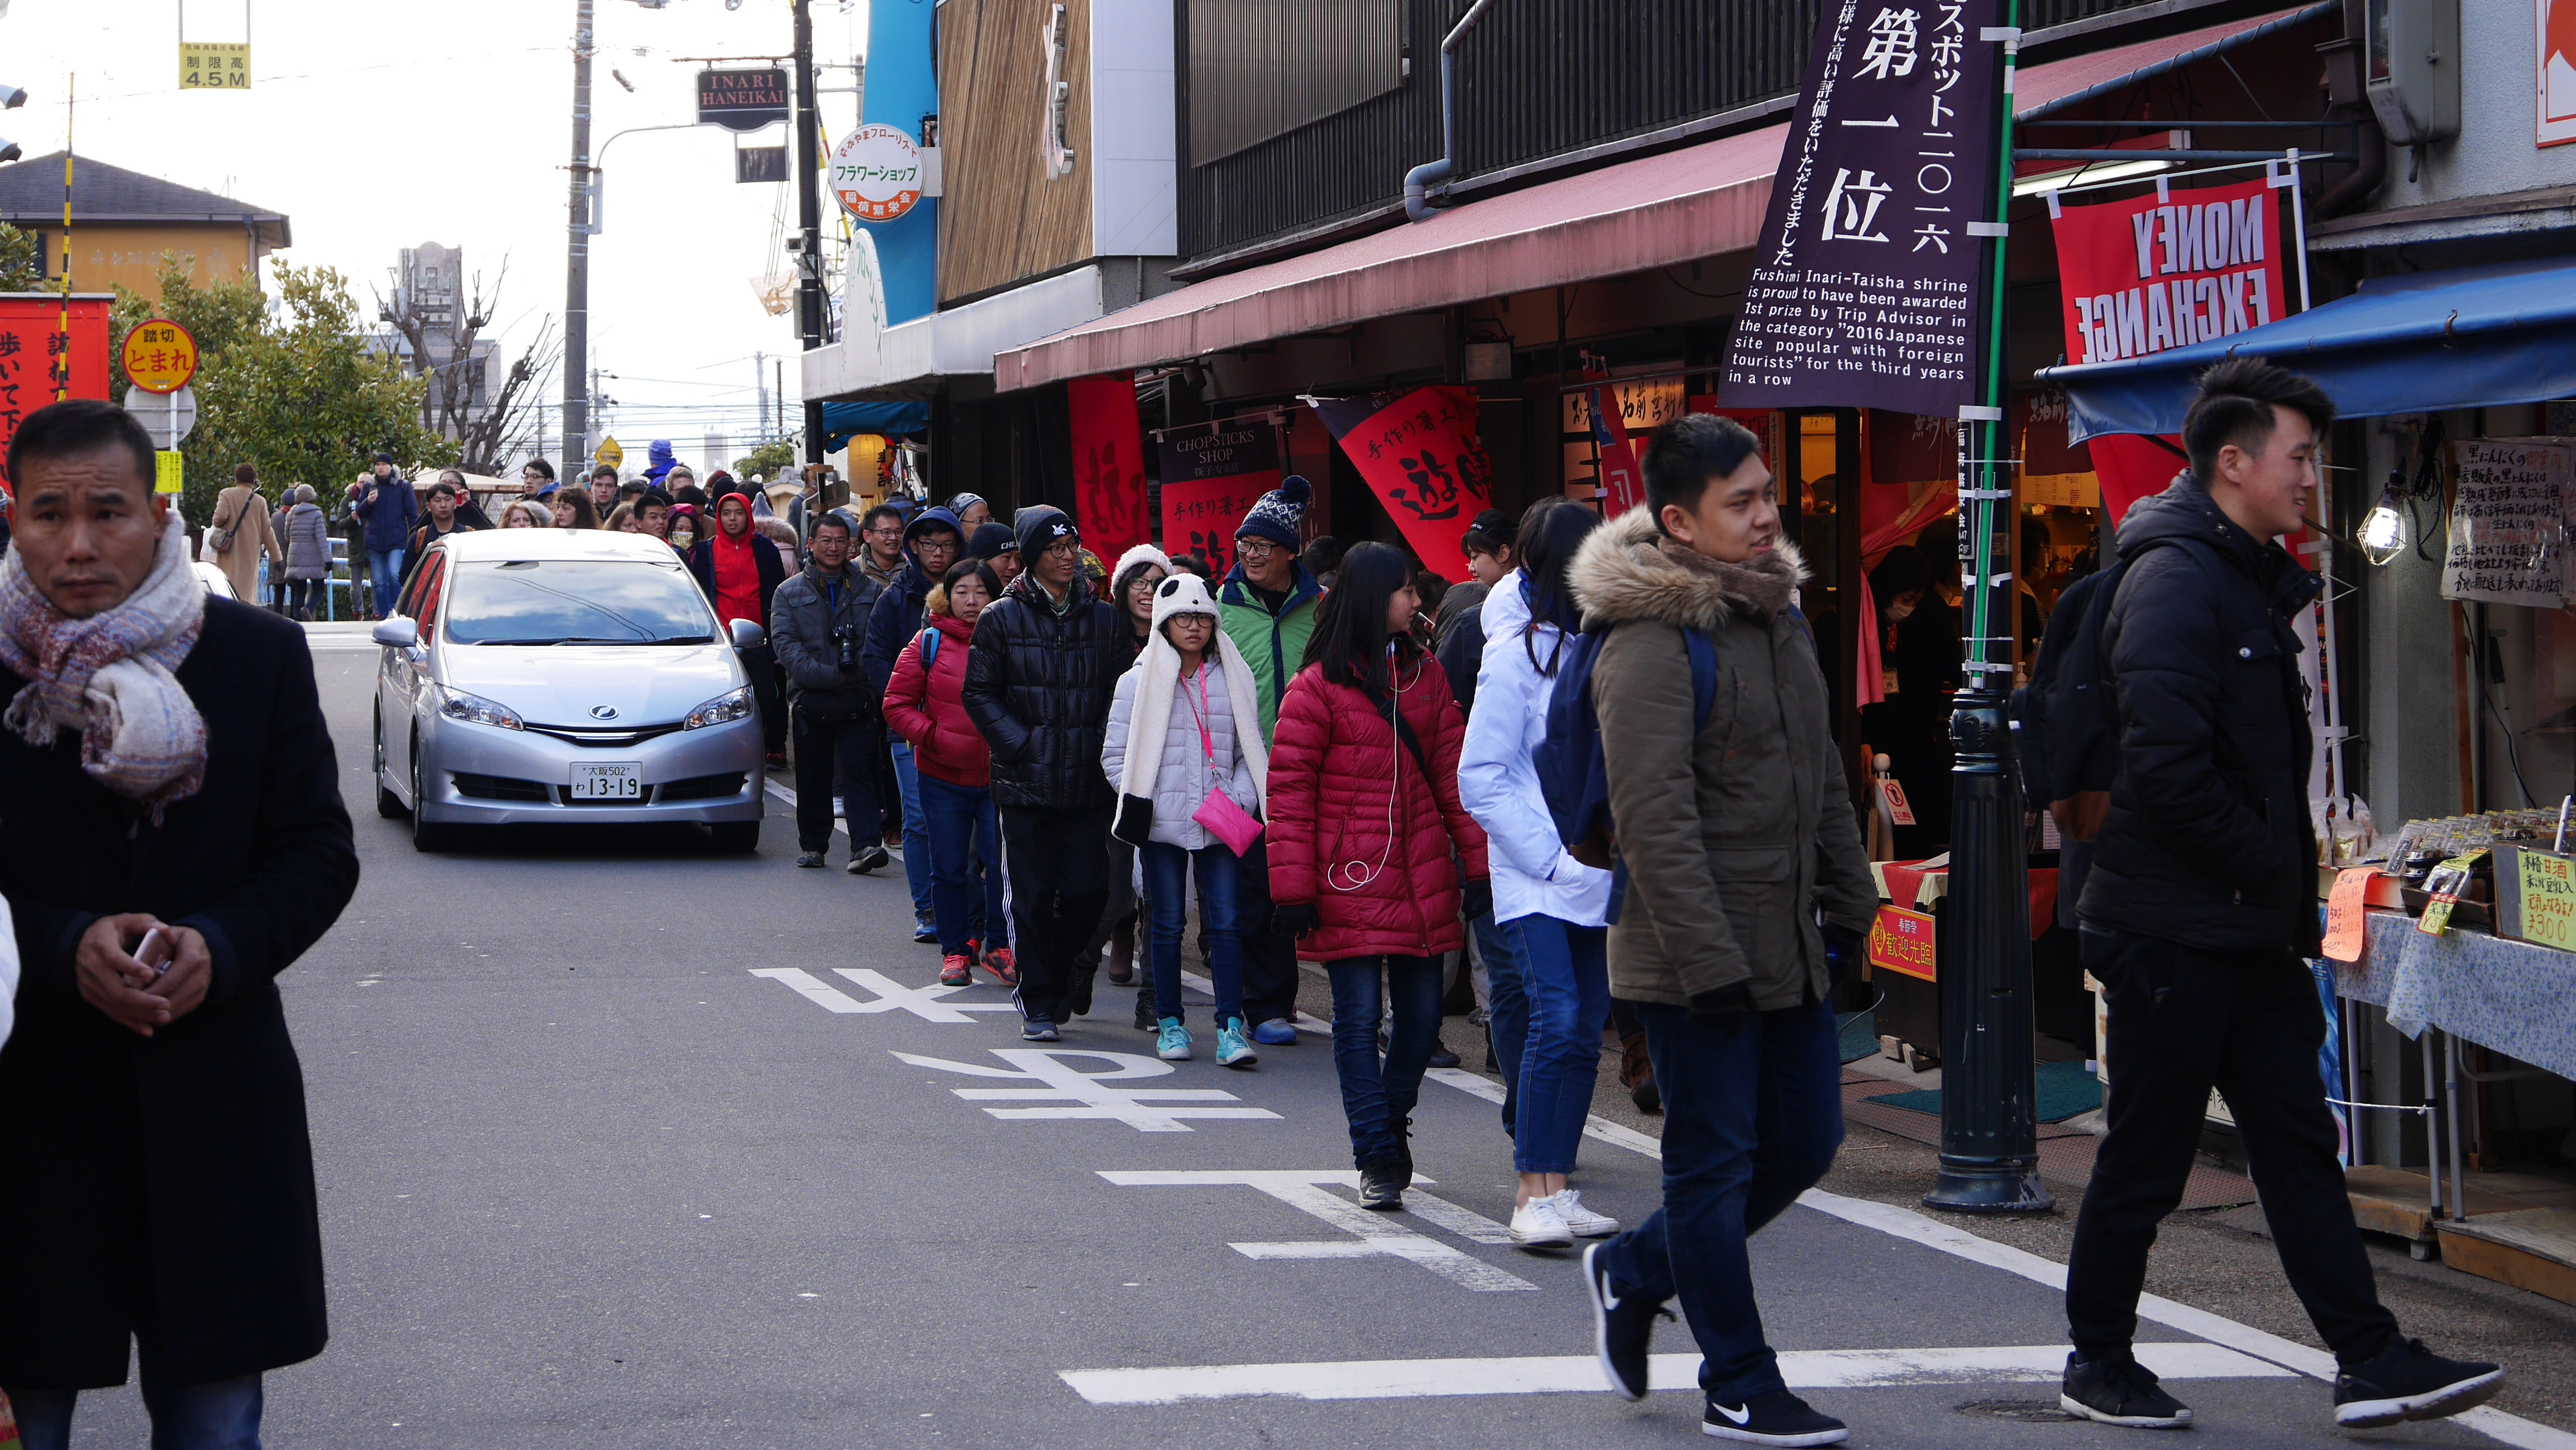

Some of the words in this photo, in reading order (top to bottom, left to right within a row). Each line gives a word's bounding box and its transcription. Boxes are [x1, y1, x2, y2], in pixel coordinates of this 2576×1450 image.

[186, 56, 243, 68] 制限高
[711, 74, 774, 89] INARI
[702, 90, 785, 105] HANEIKAI
[1821, 7, 1921, 242] 第一位
[1912, 0, 1965, 254] スポット二〇一六
[840, 129, 917, 158] なかやまフローリスト
[836, 164, 918, 182] フラワーショップ
[845, 191, 910, 216] 稲荷繁栄会
[1752, 268, 1801, 283] Fushimi
[1806, 269, 1905, 289] Inari-Taisha
[1913, 278, 1967, 292] shrine
[1748, 285, 1759, 297] is
[1762, 287, 1798, 299] proud
[1802, 287, 1816, 300] to
[1821, 287, 1853, 302] have
[1860, 291, 1896, 306] been
[1902, 296, 1967, 310] awarded
[1745, 302, 1763, 314] 1st
[1768, 304, 1802, 316] prize
[1810, 304, 1828, 320] by
[1837, 306, 1867, 323] Trip
[1876, 310, 1942, 325] Advisor
[1952, 314, 1966, 327] in
[144, 328, 174, 343] 踏切
[1740, 319, 1761, 332] the
[1767, 322, 1834, 338] category
[1886, 328, 1965, 346] Japanese
[129, 348, 191, 372] とまれ
[1735, 336, 1763, 349] site
[1776, 341, 1839, 354] popular
[1852, 343, 1886, 357] with
[1898, 346, 1963, 363] foreign
[1729, 369, 1741, 382] in
[1748, 374, 1756, 384] a
[1764, 375, 1792, 386] row
[1806, 357, 1829, 370] for
[1837, 359, 1863, 370] the
[1871, 360, 1911, 376] third
[1920, 368, 1964, 379] years
[1176, 430, 1255, 453] CHOPSTICKS
[1199, 448, 1234, 464] SHOP
[1000, 541, 1018, 550] CHE
[590, 778, 637, 795] 13-19
